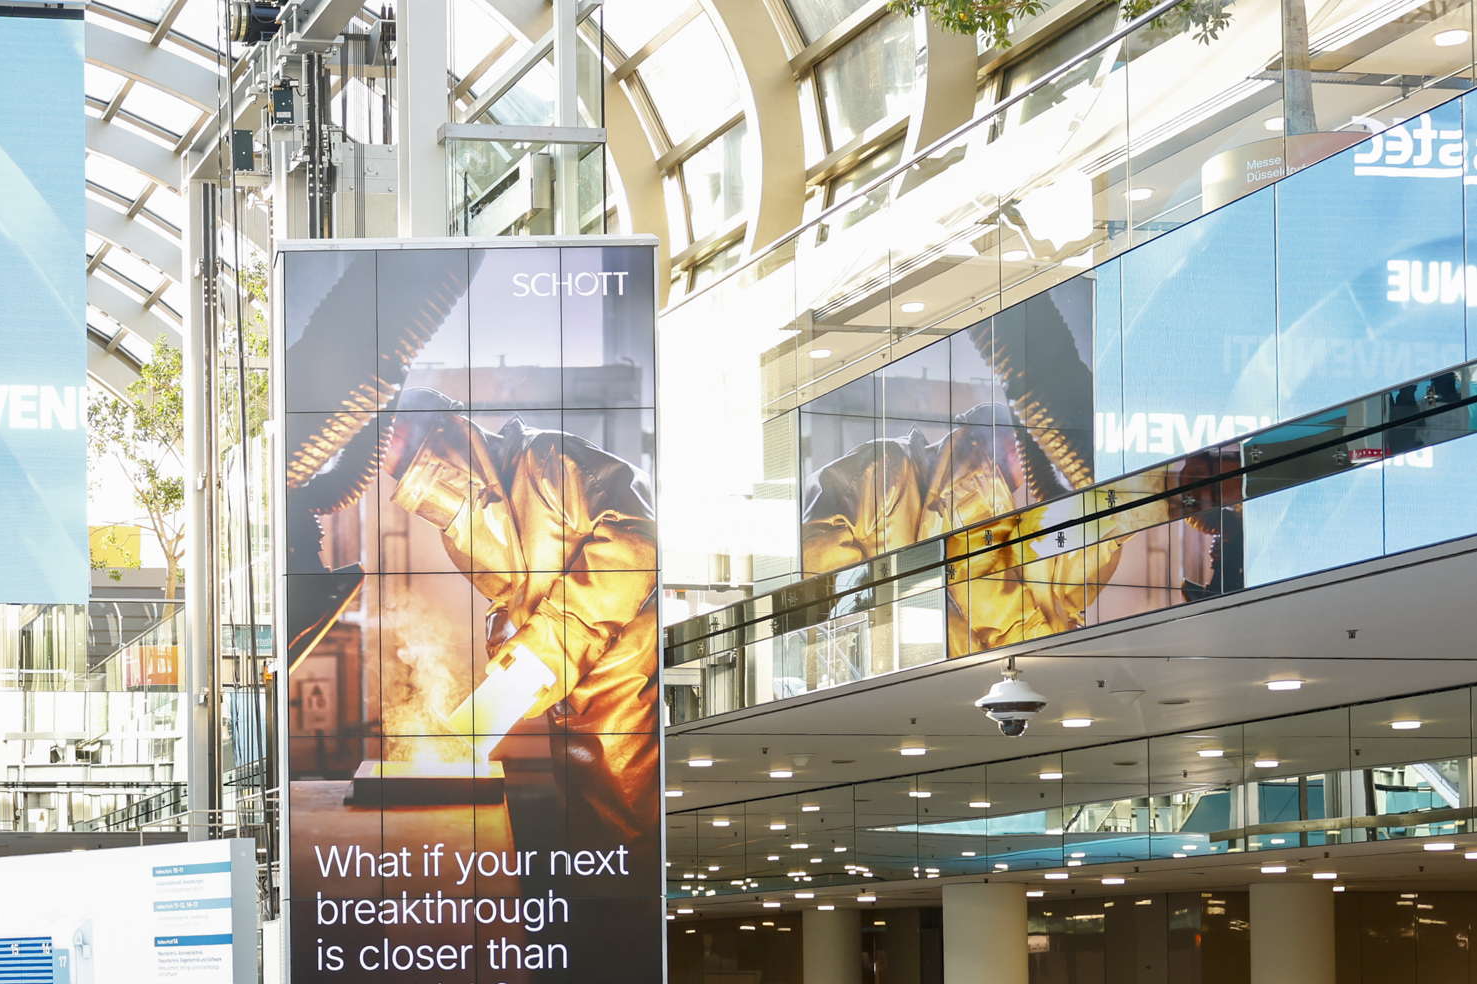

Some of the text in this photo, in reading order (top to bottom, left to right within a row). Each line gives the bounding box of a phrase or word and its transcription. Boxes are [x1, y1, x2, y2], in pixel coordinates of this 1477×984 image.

[1246, 156, 1282, 171] Messe
[512, 271, 629, 297] SCHOTT
[314, 843, 629, 885] What if your next
[317, 890, 569, 932] breakthrough
[11, 944, 19, 955] 15
[41, 943, 50, 954] 16
[316, 938, 568, 971] is closer than
[58, 956, 67, 967] 17
